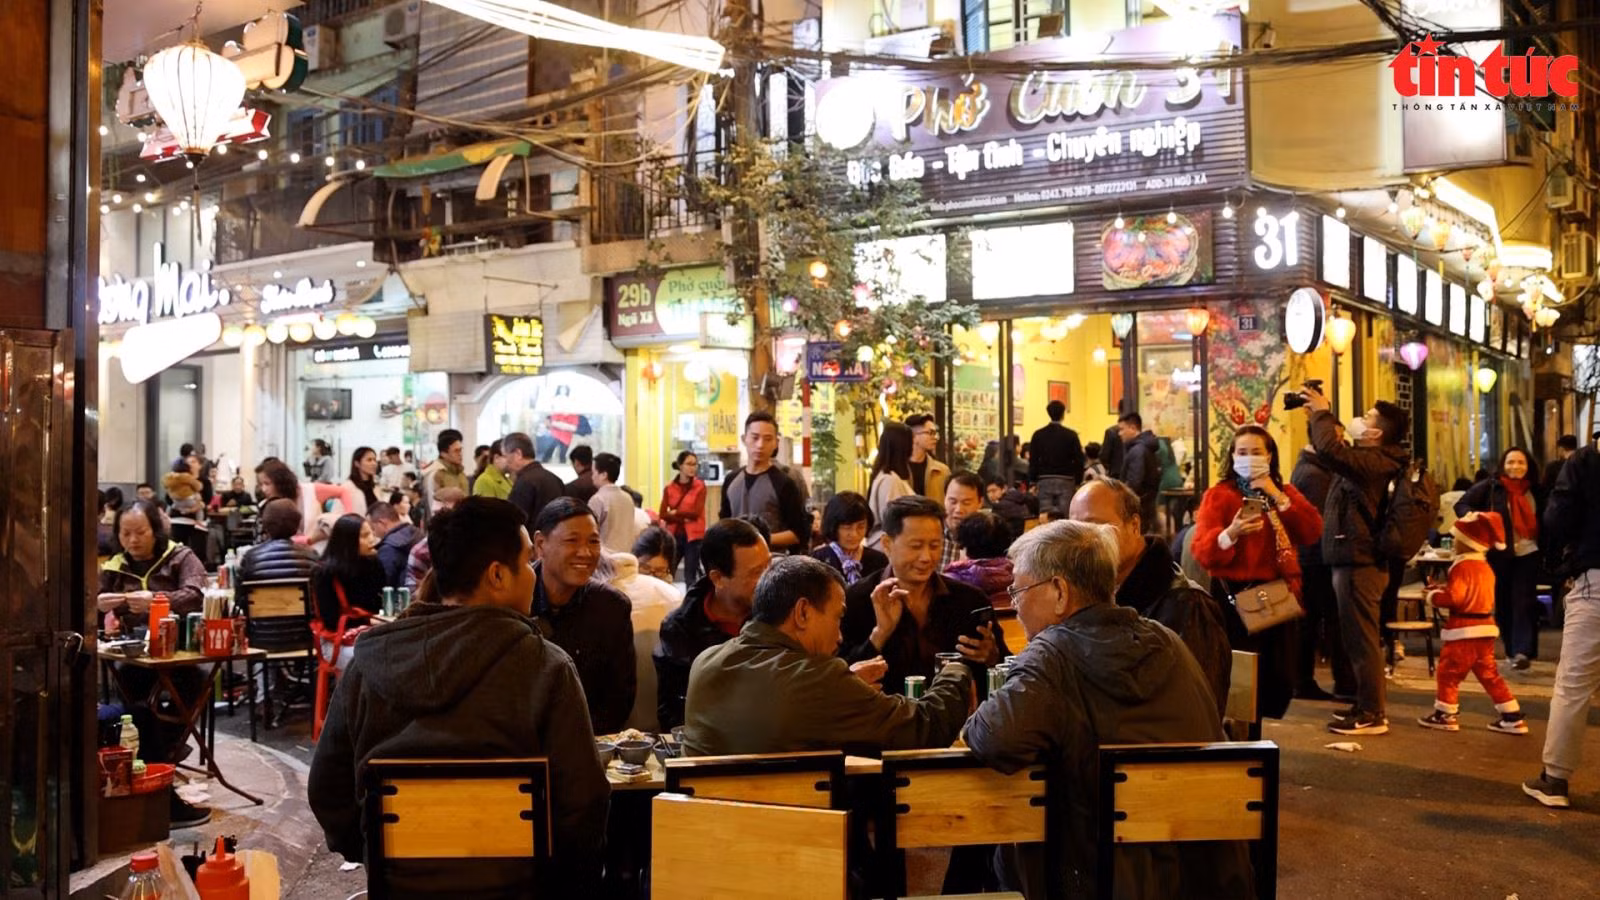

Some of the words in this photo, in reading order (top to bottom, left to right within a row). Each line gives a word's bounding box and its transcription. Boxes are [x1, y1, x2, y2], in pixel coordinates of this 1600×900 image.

[1046, 126, 1122, 163] Chuyên
[1129, 116, 1201, 157] nghiệp
[1254, 209, 1300, 270] 31
[617, 283, 652, 308] 29b
[1241, 317, 1254, 329] 31
